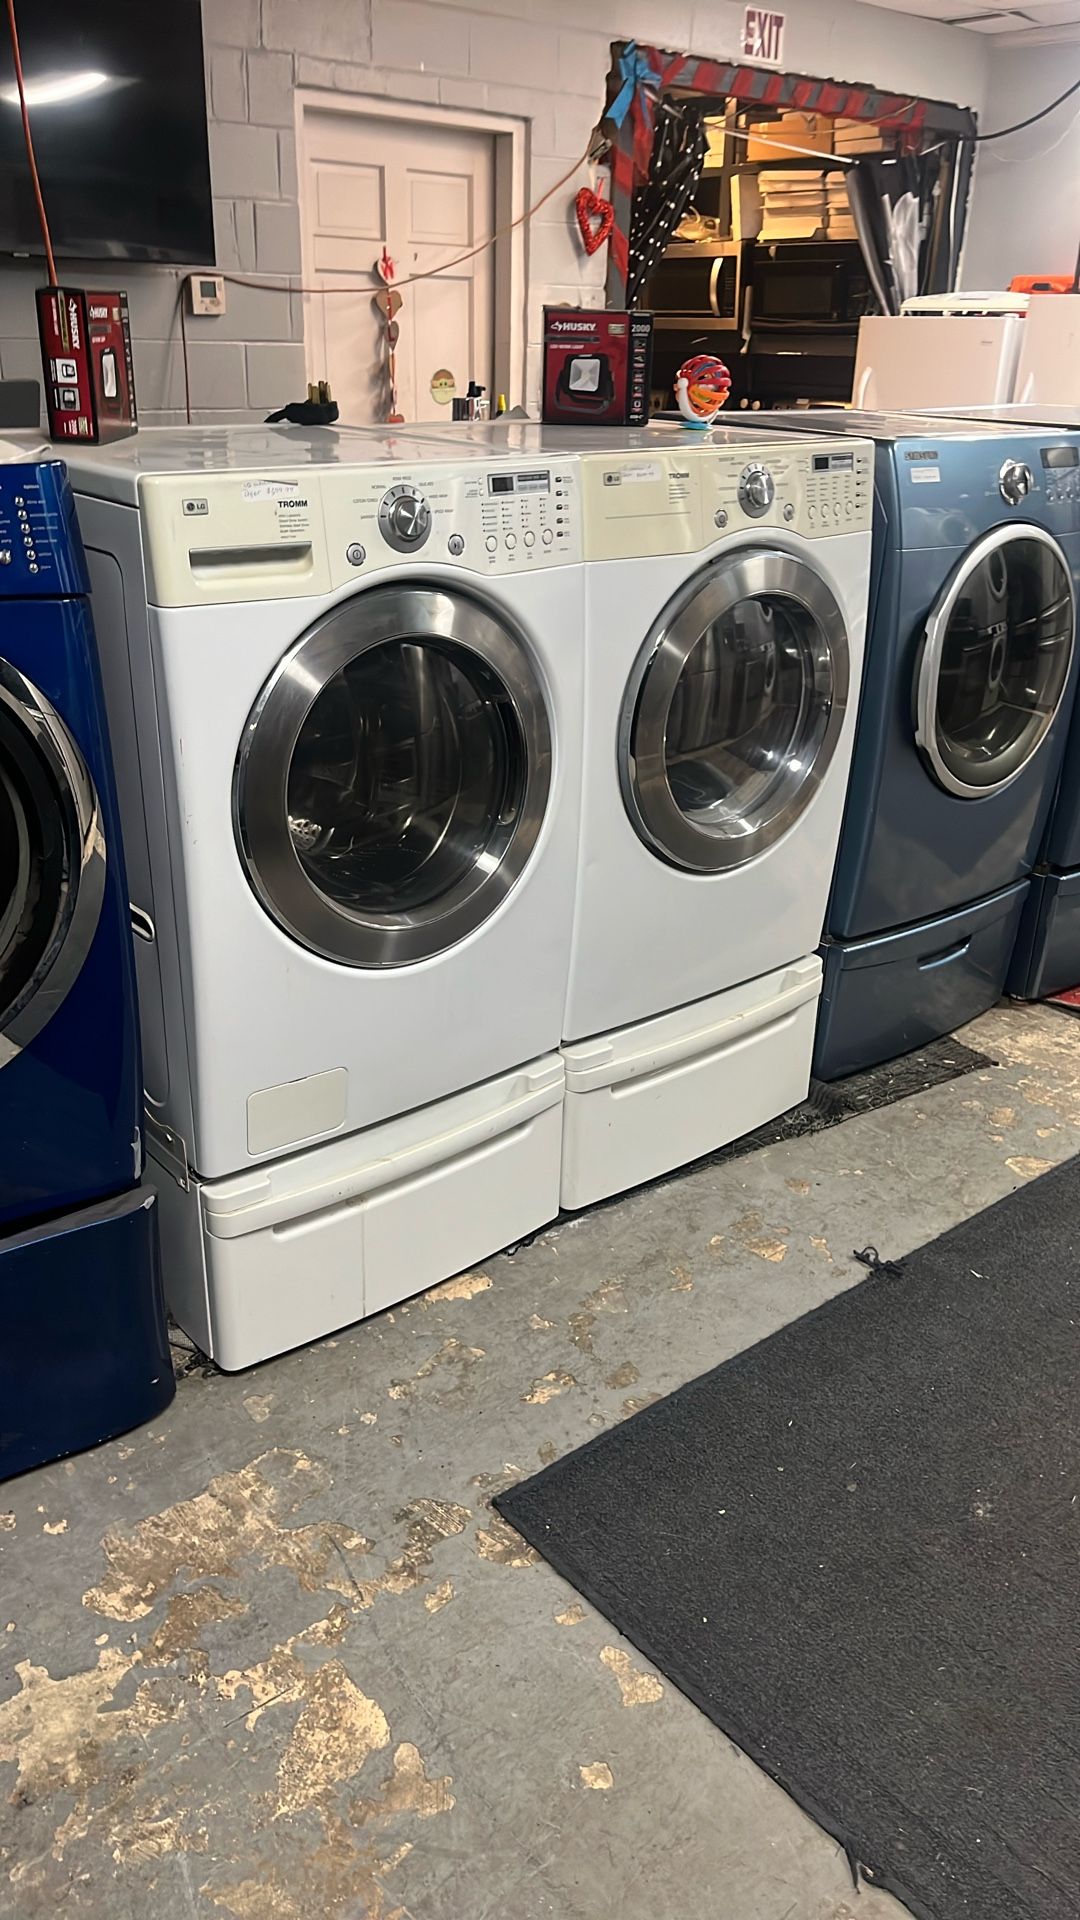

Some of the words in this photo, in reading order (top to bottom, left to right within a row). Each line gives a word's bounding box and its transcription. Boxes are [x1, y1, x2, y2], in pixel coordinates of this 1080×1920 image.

[744, 10, 784, 60] EXIT
[69, 312, 80, 349] HUSKY
[562, 322, 597, 331] HUSKY
[631, 324, 651, 333] 2000
[277, 499, 309, 509] TROMM
